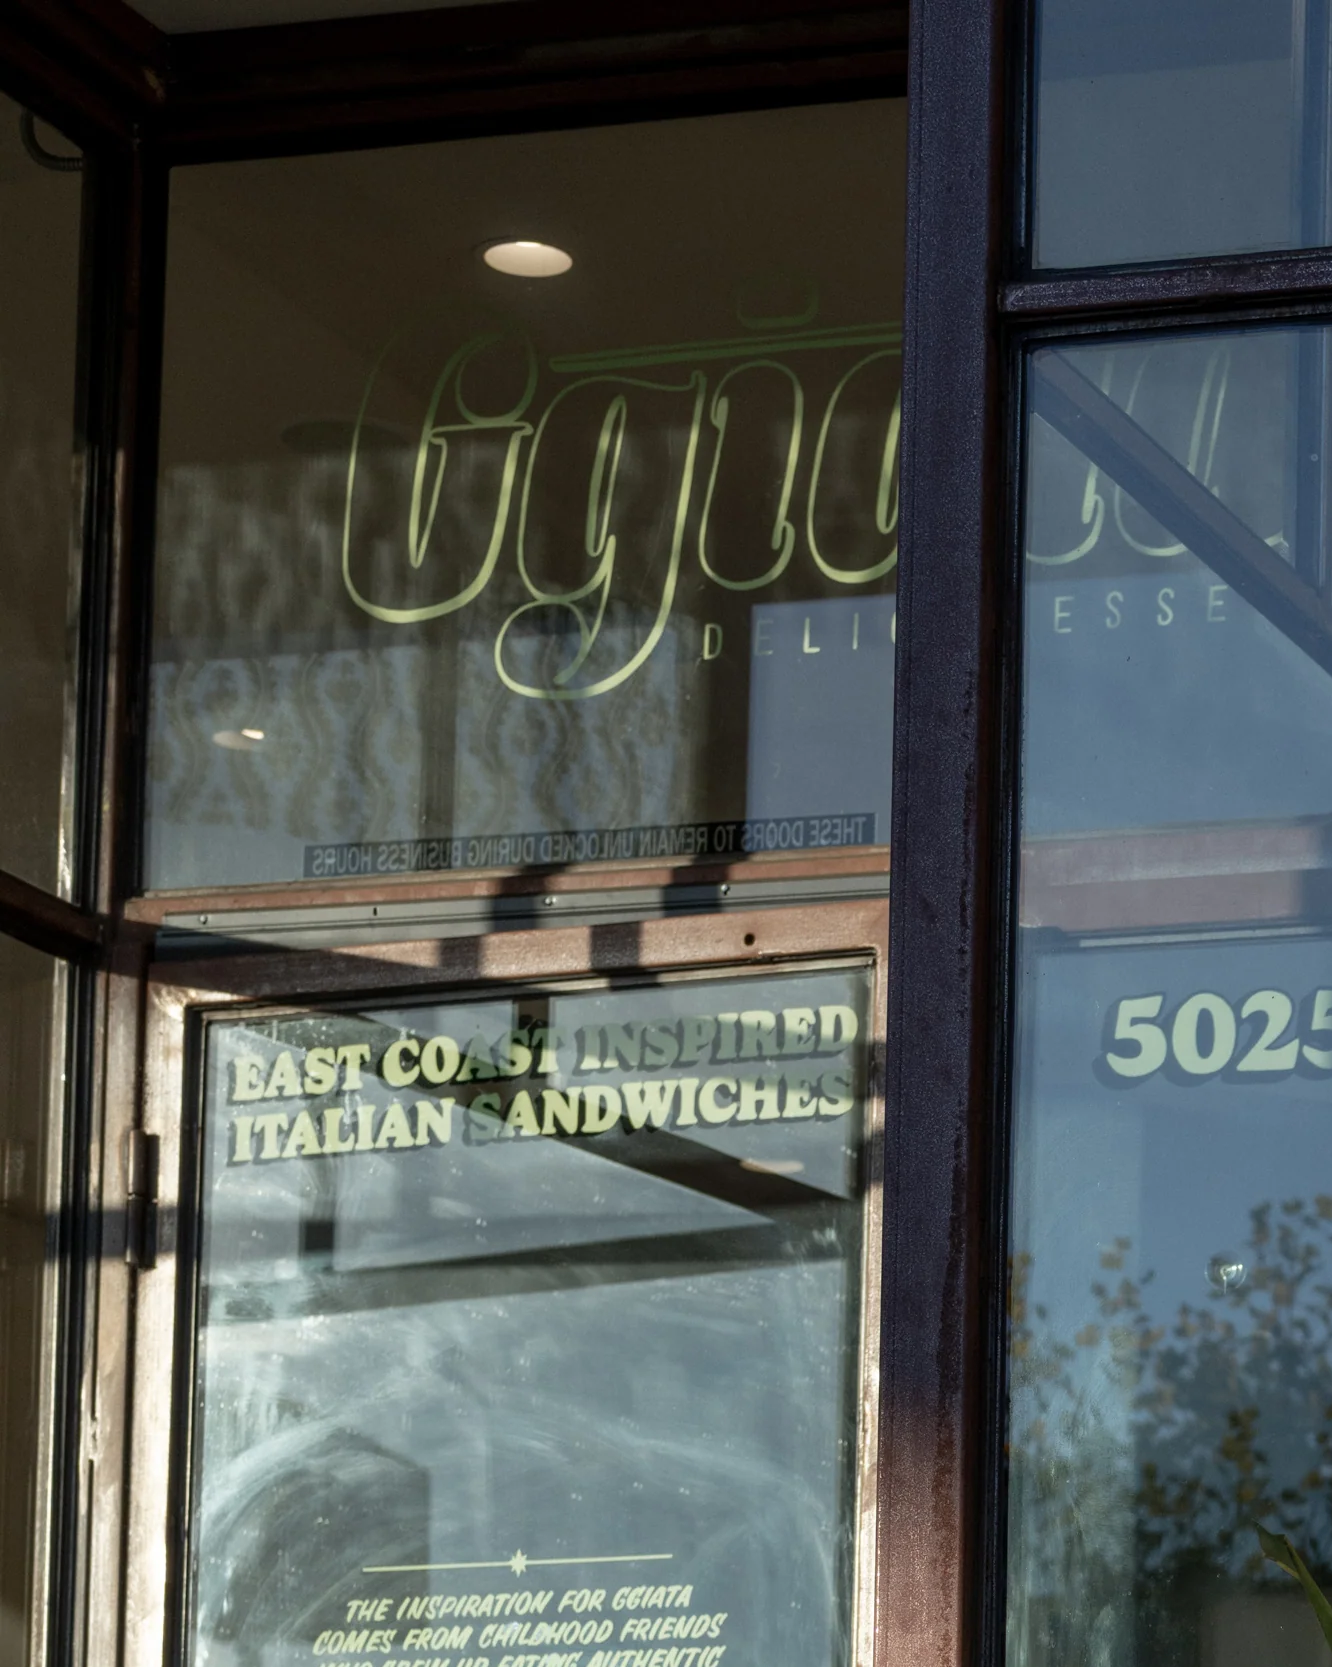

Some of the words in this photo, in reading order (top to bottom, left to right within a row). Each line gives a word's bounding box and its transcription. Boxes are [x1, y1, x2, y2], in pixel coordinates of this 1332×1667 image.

[232, 1045, 371, 1101] EAST
[380, 1027, 564, 1087] COAST
[577, 1005, 859, 1070] INSPIRED
[232, 1099, 456, 1163] ITALIAN
[464, 1072, 855, 1141] SANDWICHES
[313, 1628, 394, 1656] COMES
[402, 1625, 473, 1653] FROM
[479, 1620, 613, 1648] CHILDHOOD
[620, 1613, 727, 1642] FRIENDS
[347, 1598, 392, 1622] THE
[396, 1590, 553, 1620] INSPIRATION
[558, 1588, 604, 1612] FOR
[612, 1585, 693, 1610] GGIATA
